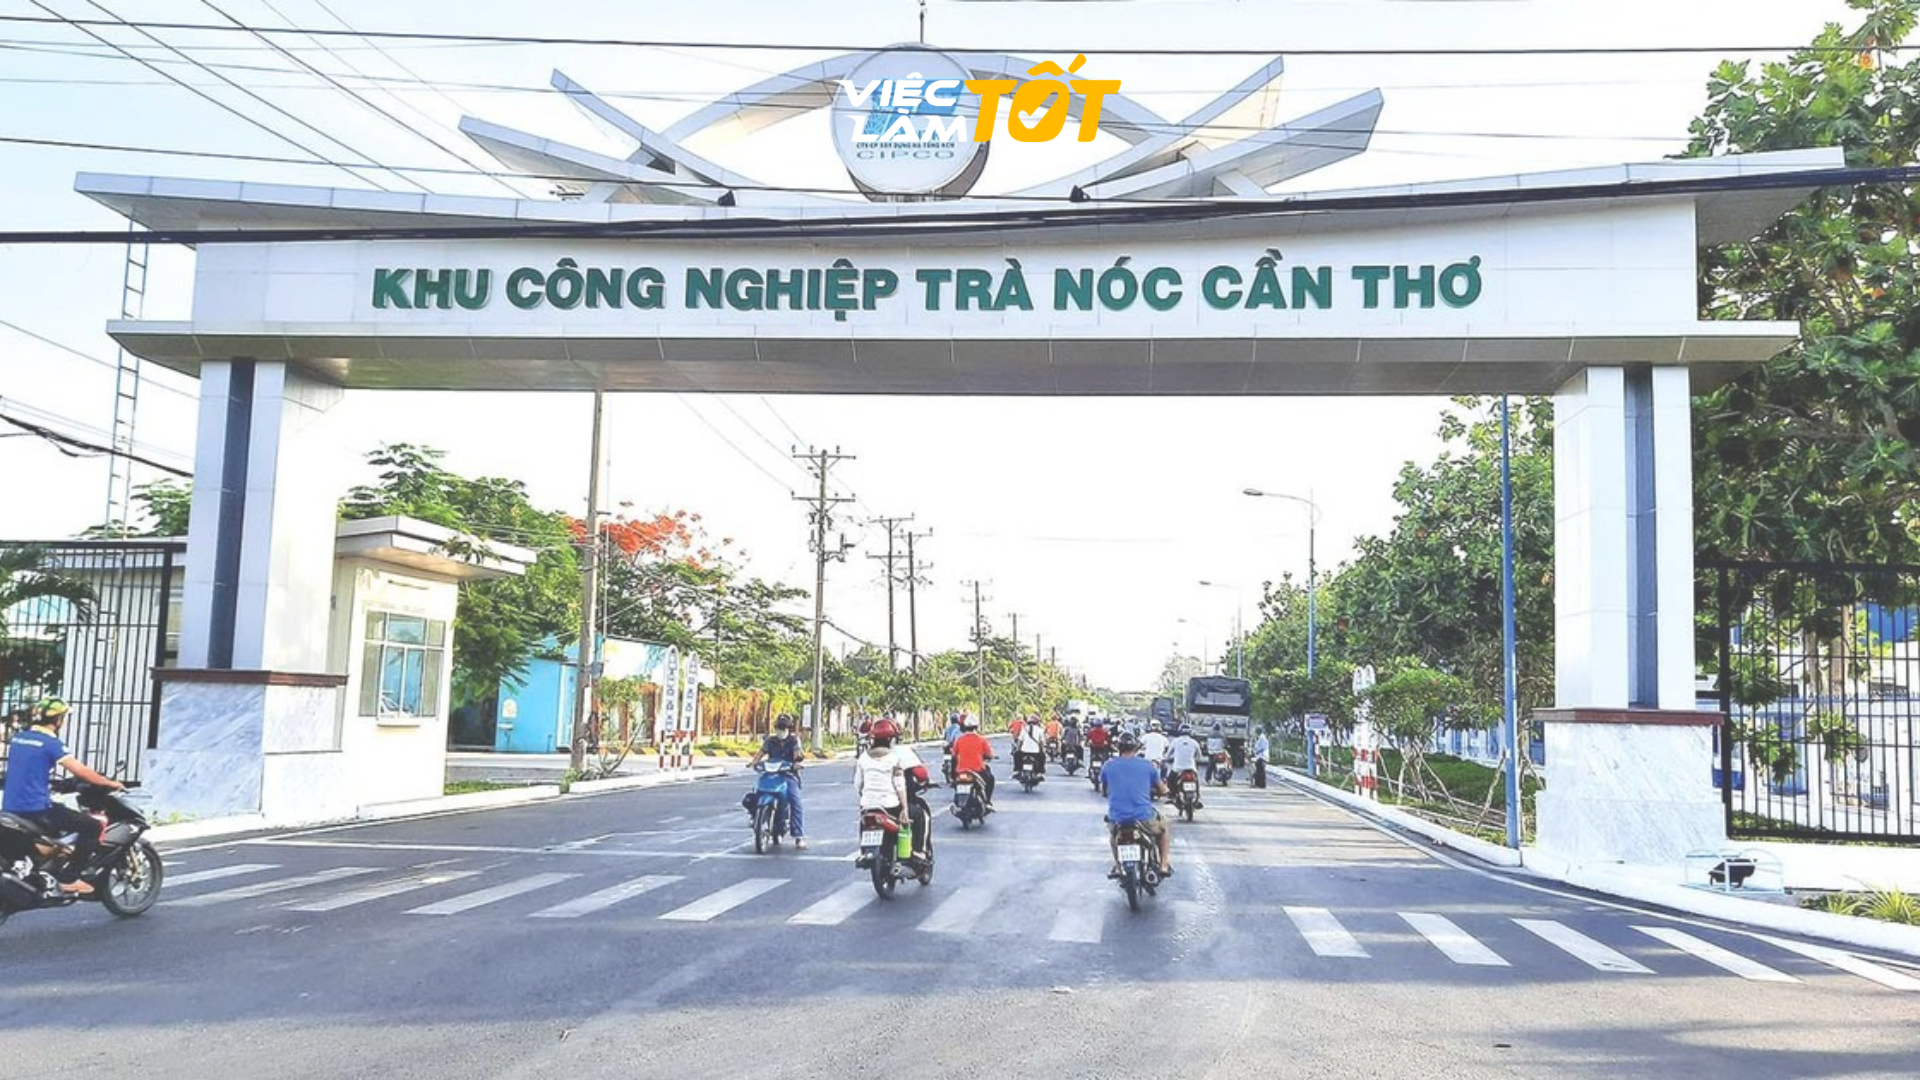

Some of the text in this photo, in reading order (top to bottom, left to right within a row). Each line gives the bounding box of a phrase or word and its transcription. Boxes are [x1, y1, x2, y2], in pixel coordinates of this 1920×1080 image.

[856, 150, 955, 160] CIPCO
[372, 248, 1482, 321] KHU CÔNG NGHIỆP TRÀ NÓC CẦN THƠ
